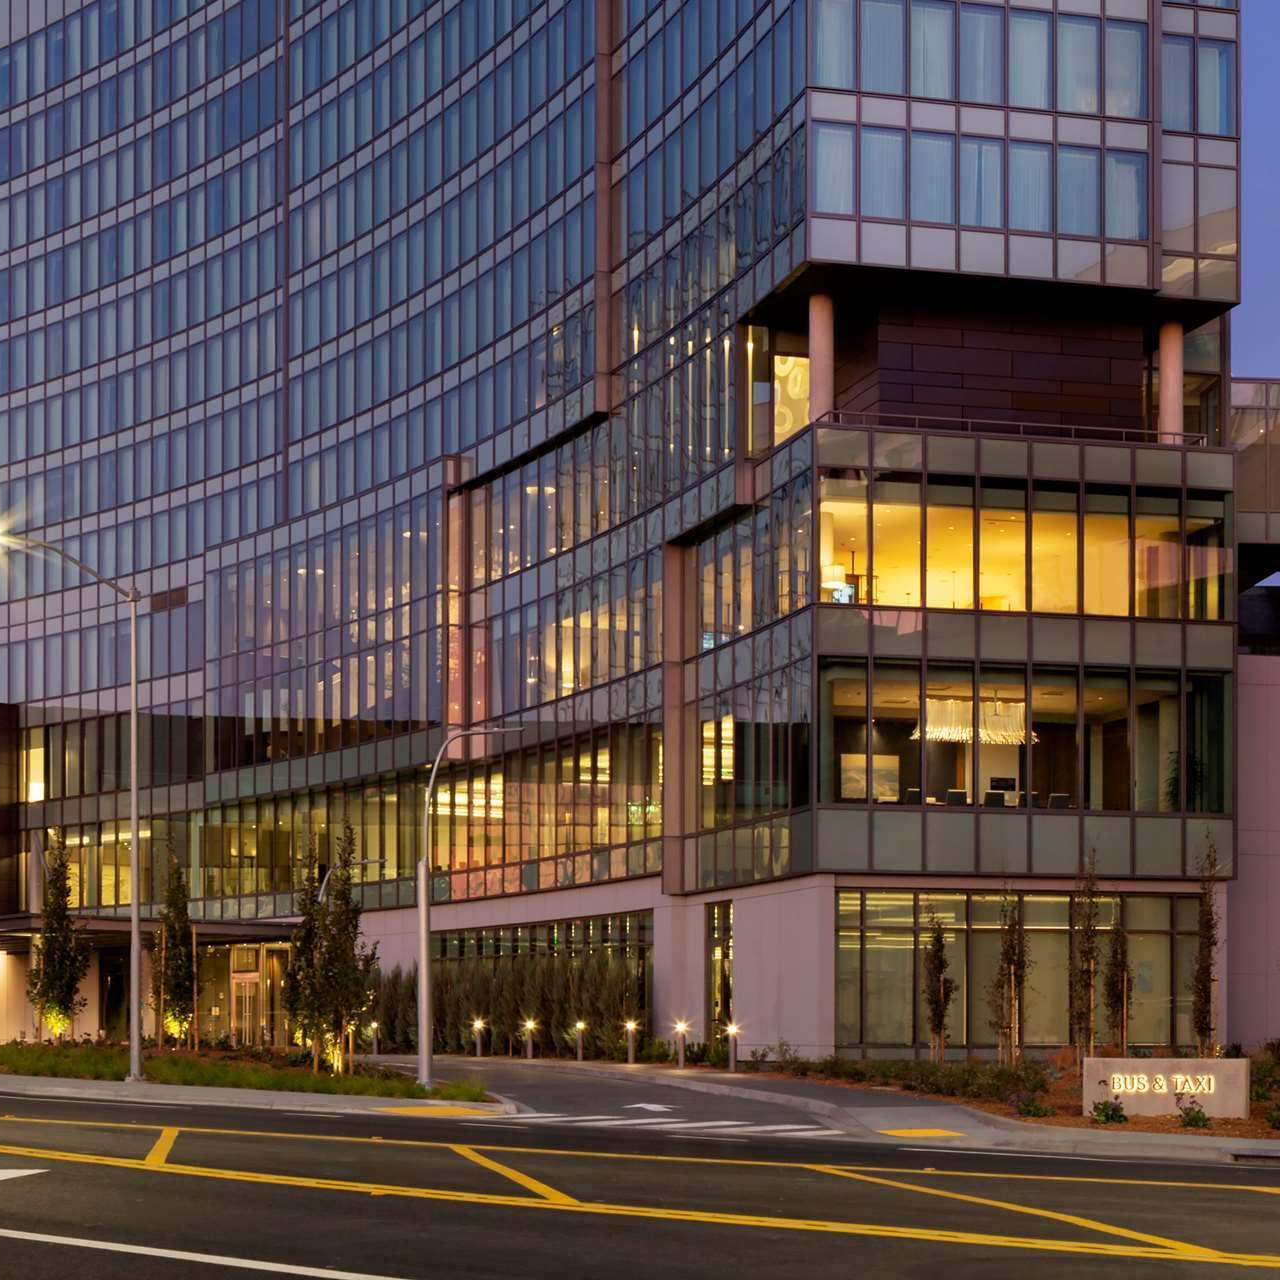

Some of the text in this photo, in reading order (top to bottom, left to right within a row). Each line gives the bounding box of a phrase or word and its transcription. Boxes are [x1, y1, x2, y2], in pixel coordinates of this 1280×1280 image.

[1111, 1074, 1215, 1093] BUS & TAXI
